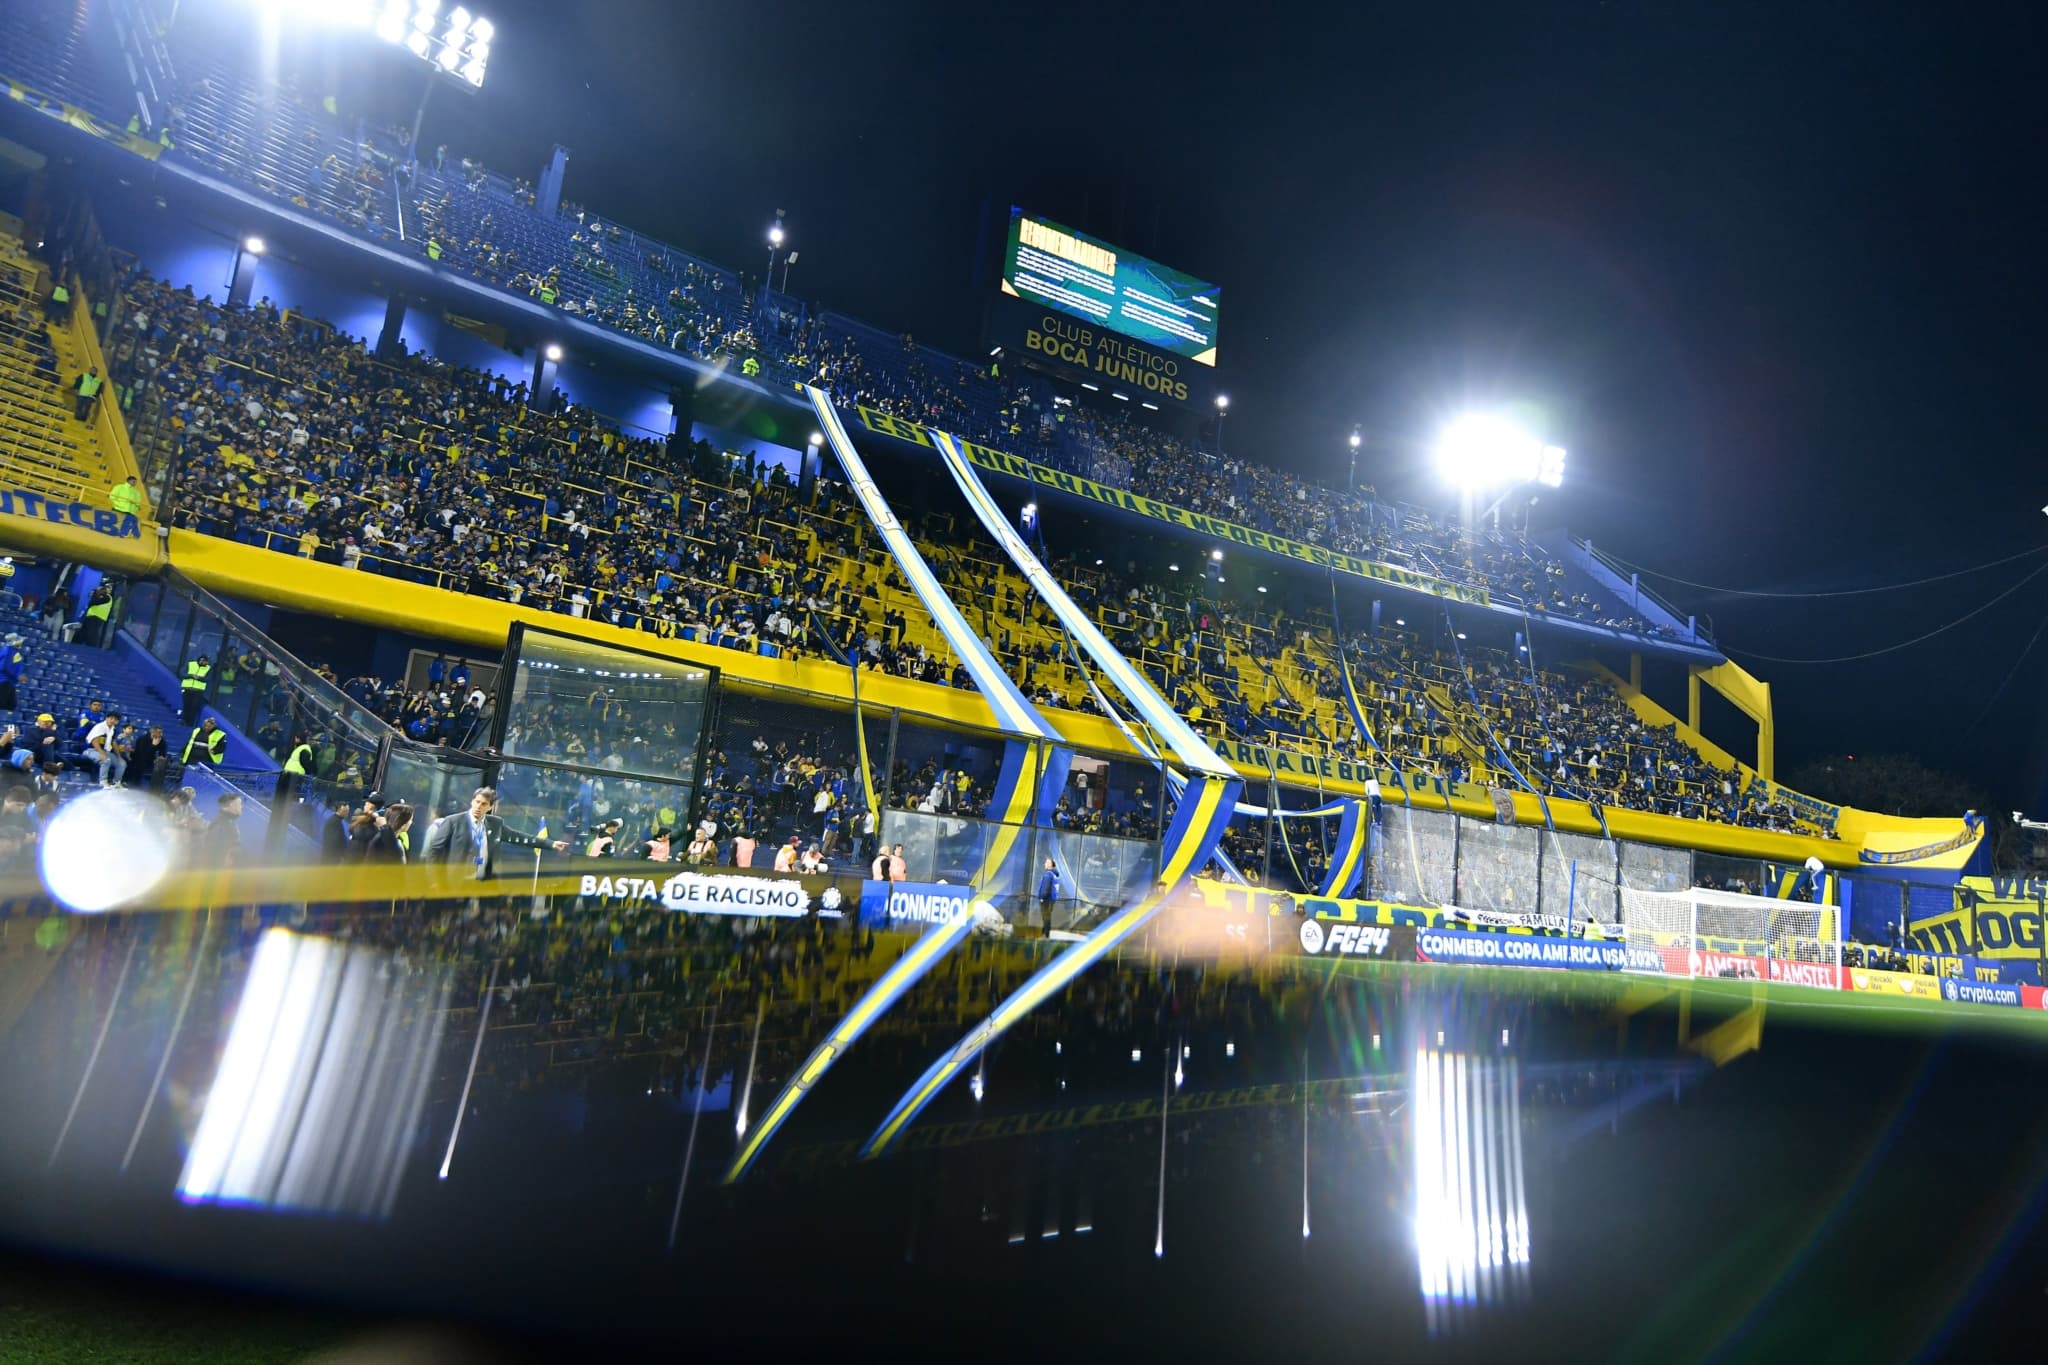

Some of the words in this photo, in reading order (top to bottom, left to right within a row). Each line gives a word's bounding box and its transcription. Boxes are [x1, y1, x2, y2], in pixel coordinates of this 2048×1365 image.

[1042, 316, 1092, 346] CLUB
[1097, 336, 1178, 377] ATLÉTICO
[1026, 329, 1089, 367] BOCA
[1095, 354, 1188, 401] JUNIORS
[866, 410, 935, 446] EST
[1203, 737, 1296, 772] ARRA
[1301, 755, 1333, 777] DE
[581, 875, 658, 900] BASTA
[672, 883, 700, 901] DE
[706, 885, 800, 908] RACISMO
[1421, 934, 1504, 959] CONMEBOL
[1504, 940, 1542, 960] COPA
[1542, 943, 1602, 965] AMRICA
[1602, 949, 1627, 967] USA
[1782, 962, 1835, 988] AMSTEL
[1959, 985, 2017, 1003] crypto.com
